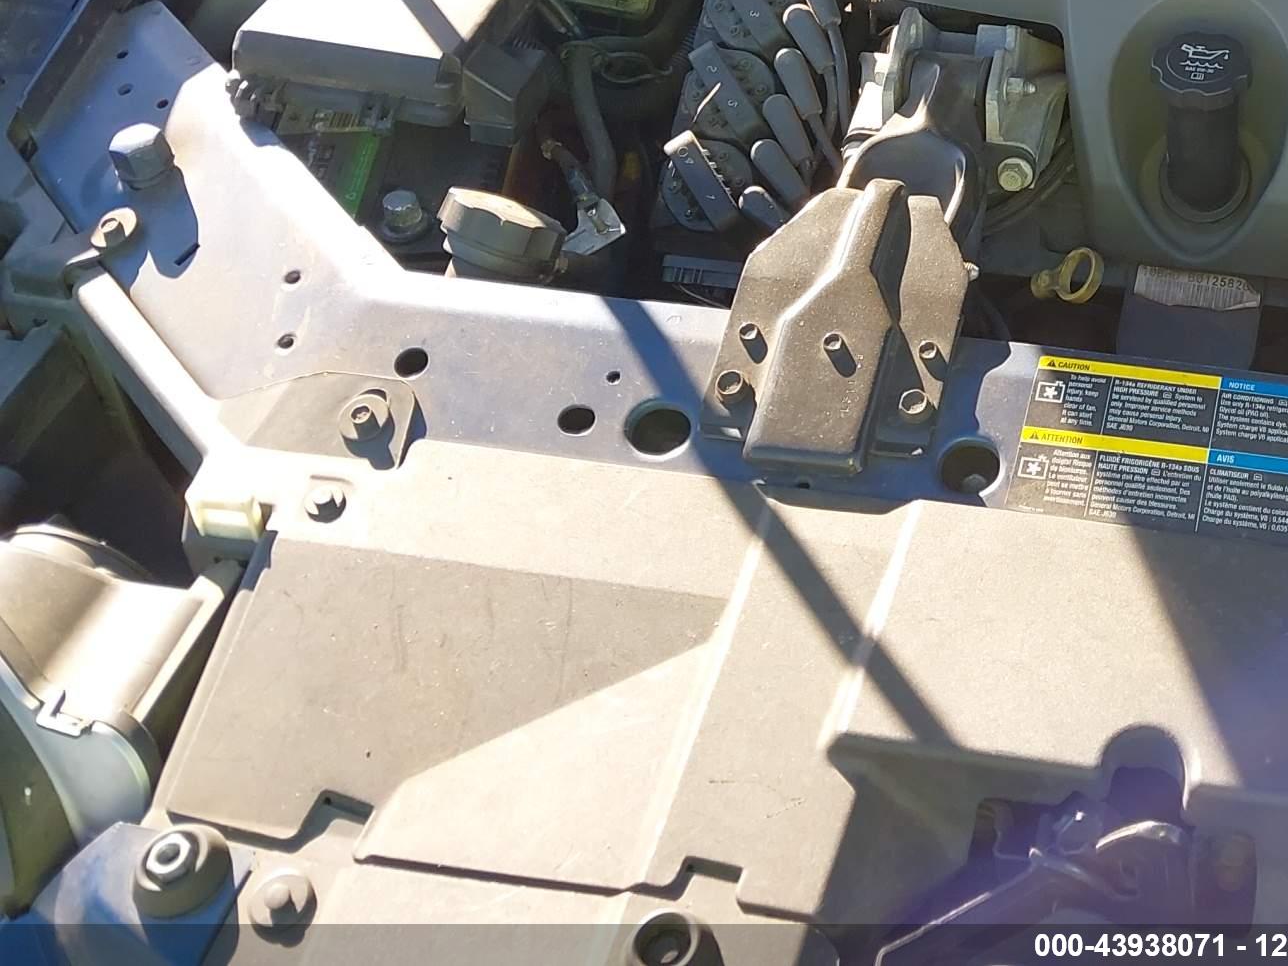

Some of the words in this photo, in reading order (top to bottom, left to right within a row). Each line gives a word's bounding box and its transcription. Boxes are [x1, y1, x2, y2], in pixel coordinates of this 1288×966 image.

[1057, 361, 1090, 371] CAUTION
[1228, 381, 1255, 391] NOTICE
[1232, 394, 1274, 404] CONDITIONING
[1106, 415, 1128, 423] General
[1128, 417, 1147, 426] Motors
[1041, 433, 1082, 443] ATTENTION
[1216, 452, 1234, 463] AVIS
[1097, 462, 1118, 470] HAUTE
[1118, 465, 1148, 474] PRESSION
[1209, 468, 1249, 479] CLIMATISEUR
